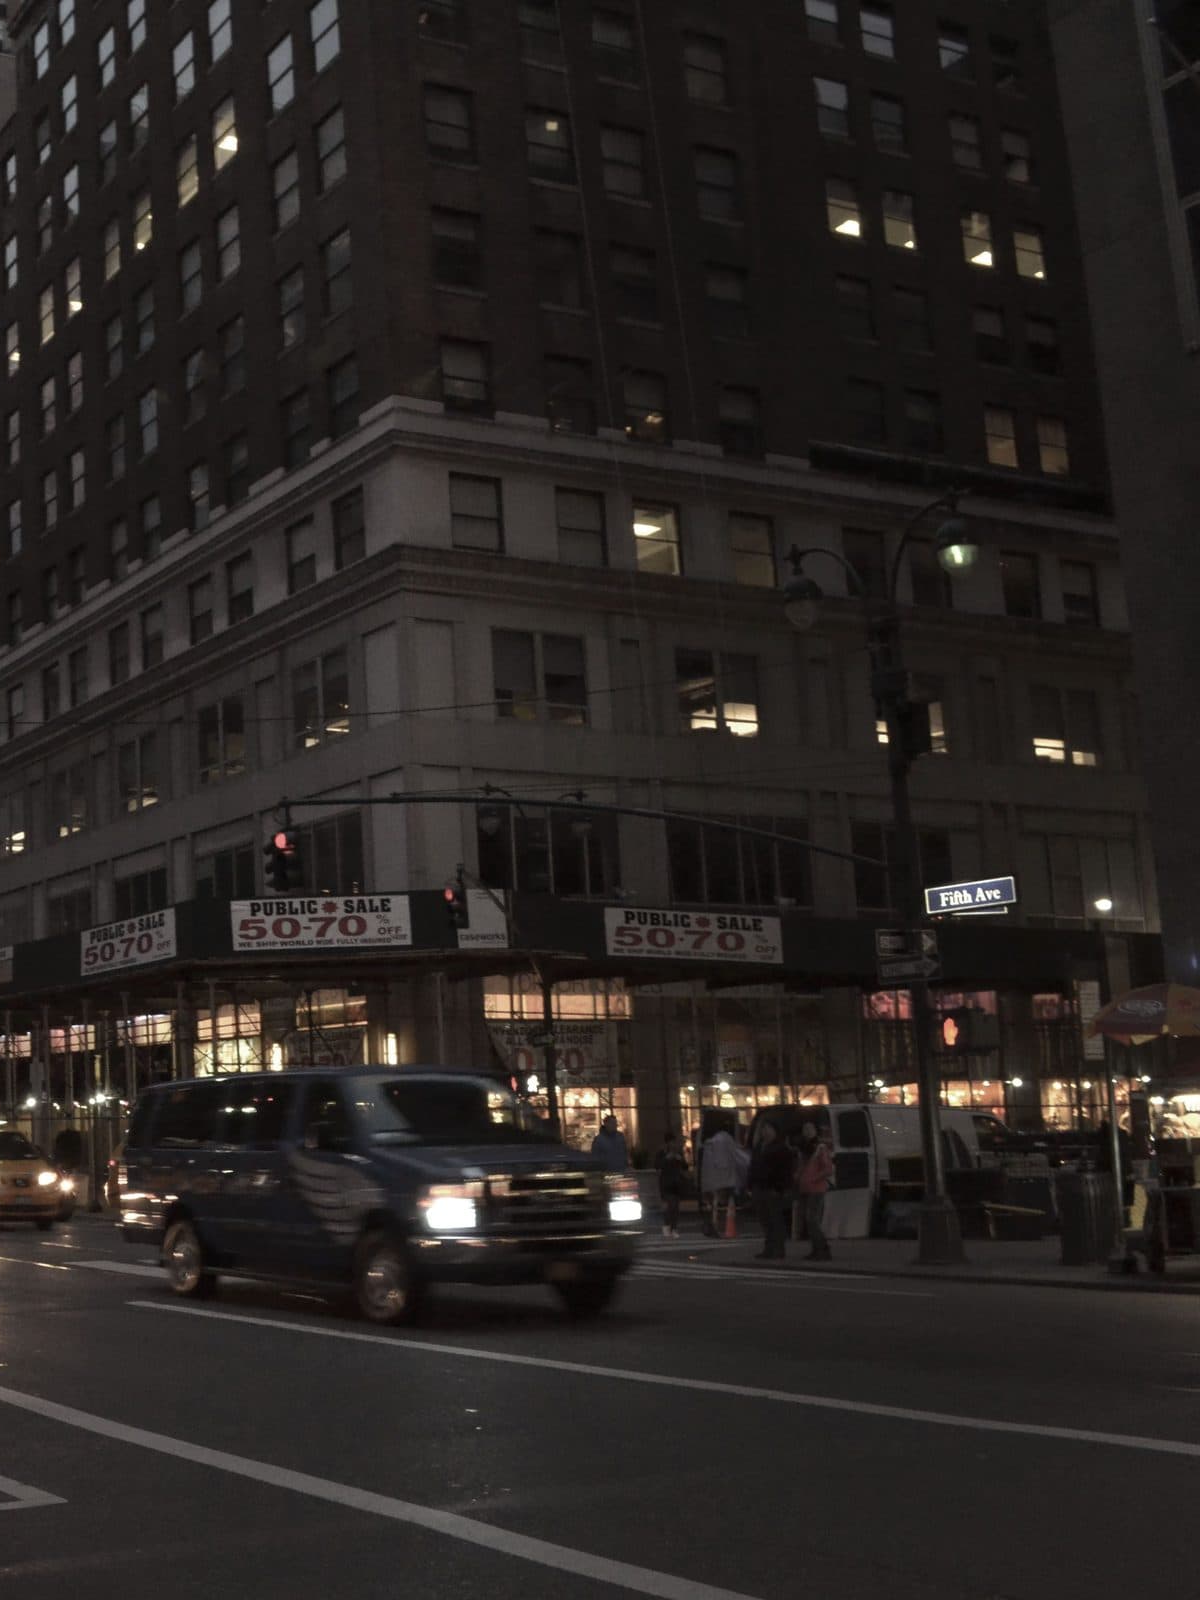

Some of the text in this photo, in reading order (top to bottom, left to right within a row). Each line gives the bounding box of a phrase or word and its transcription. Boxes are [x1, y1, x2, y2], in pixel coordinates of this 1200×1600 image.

[250, 898, 391, 916] PUBLIC SALE
[939, 887, 1001, 907] Fifth Ave
[90, 912, 164, 944] PUBLIC SALE
[238, 915, 367, 940] 50-70
[378, 926, 402, 936] OFF
[624, 910, 763, 932] PUBLIC SALE
[84, 932, 153, 966] 50-70
